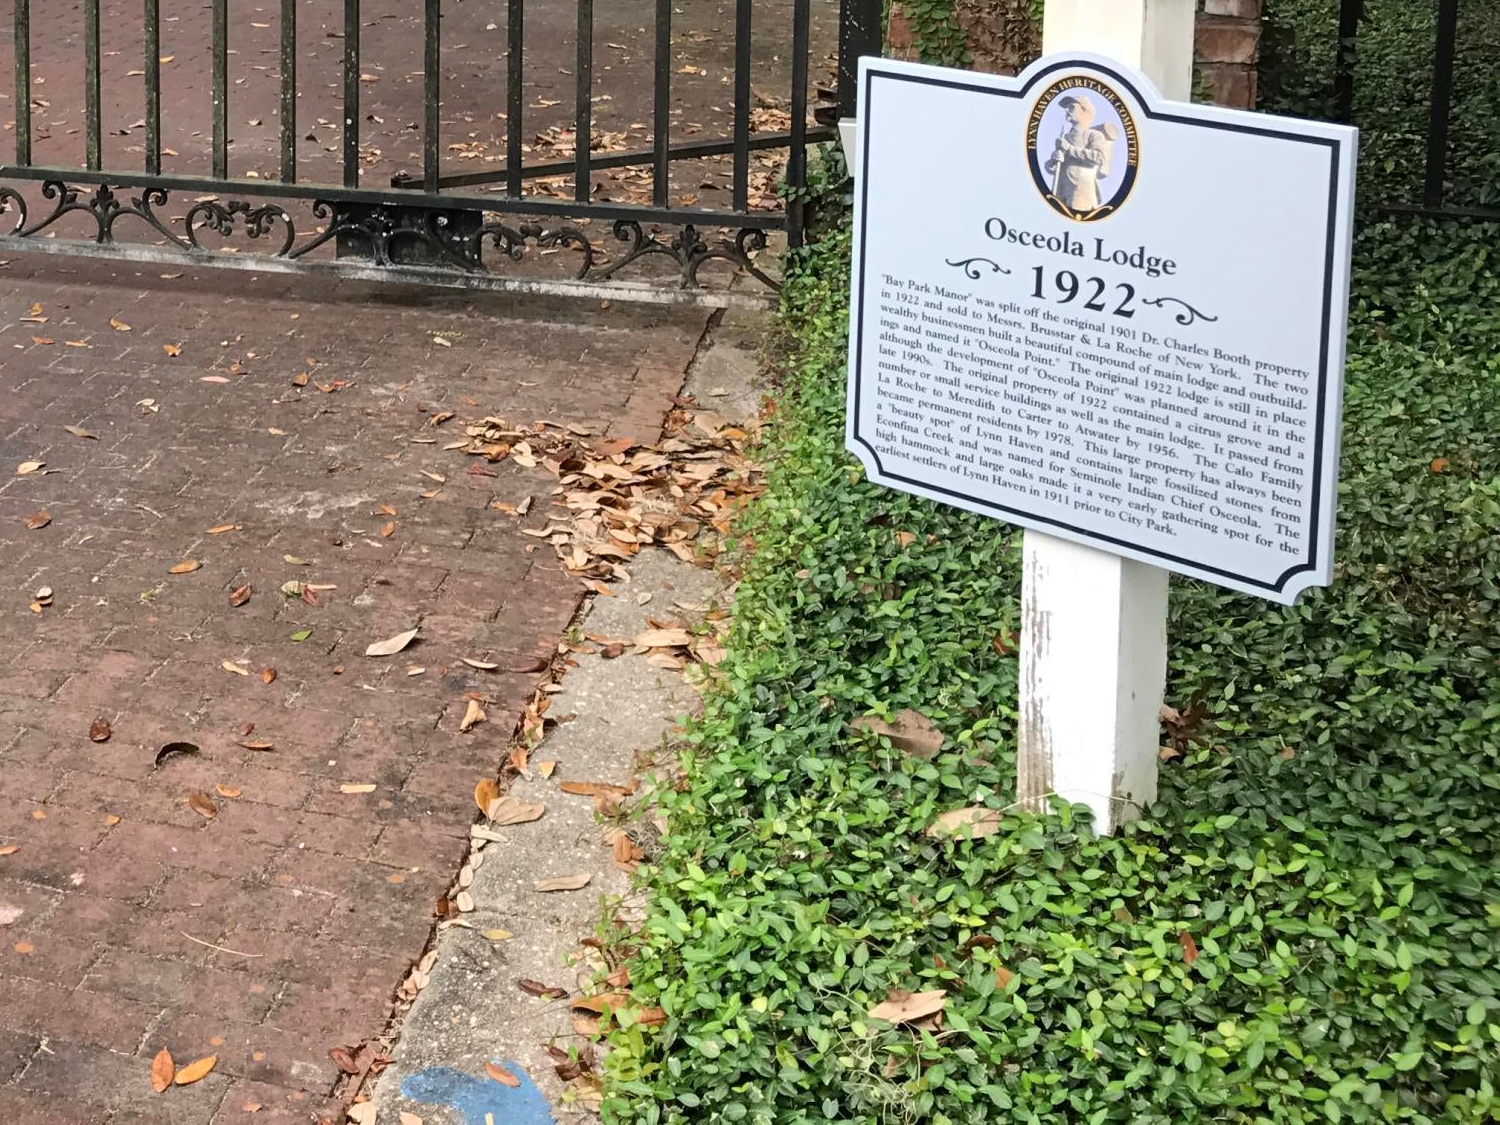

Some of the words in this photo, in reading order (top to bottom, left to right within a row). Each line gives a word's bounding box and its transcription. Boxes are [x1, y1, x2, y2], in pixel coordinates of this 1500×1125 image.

[984, 217, 1084, 257] Osceola
[1094, 237, 1177, 278] Lodge
[1030, 265, 1137, 319] 1922
[879, 315, 900, 331] ings
[902, 324, 922, 335] and
[925, 329, 960, 344] named
[1068, 360, 1092, 376] The
[1095, 370, 1139, 388] original
[1144, 379, 1172, 396] 1922
[1176, 386, 1210, 405] lodge
[1227, 401, 1251, 415] still
[1272, 411, 1307, 428] place
[880, 304, 919, 322] wealthy
[921, 311, 986, 336] businessmen
[988, 326, 1013, 342] built
[1024, 335, 1073, 357] beautiful
[1075, 350, 1136, 372] compound
[1153, 368, 1184, 383] main
[1186, 372, 1220, 392] lodge
[1222, 385, 1246, 397] and
[1248, 391, 1308, 411] outbuild-
[895, 291, 920, 306] 1922
[923, 300, 943, 311] and
[947, 304, 968, 317] sold
[986, 311, 1026, 330] Messrs.
[1030, 321, 1076, 342] Brusstar
[1079, 333, 1092, 346] &
[1096, 336, 1111, 350] La
[1115, 341, 1153, 360] Roche
[1174, 354, 1204, 371] New
[1208, 362, 1242, 380] York.
[1252, 372, 1279, 389] The
[1284, 382, 1309, 396] two
[907, 279, 931, 294] Park
[975, 297, 995, 309] was
[997, 301, 1021, 314] split
[1023, 306, 1041, 319] off
[1042, 310, 1060, 323] the
[1062, 316, 1106, 334] original
[1110, 324, 1136, 341] 1901
[1141, 331, 1160, 346] Dr.
[1163, 337, 1210, 357] Charles
[1213, 347, 1251, 367] Booth
[1254, 360, 1310, 381] property
[877, 371, 891, 384] La
[895, 376, 928, 394] Roche
[947, 389, 996, 412] Meredith
[1017, 408, 1053, 426] Carter
[1075, 423, 1121, 444] Atwater
[1125, 435, 1141, 451] by
[1148, 442, 1179, 460] 1956.
[1192, 453, 1219, 470] The
[1224, 462, 1254, 479] Calo
[1260, 470, 1304, 493] Family
[878, 343, 897, 357] late
[902, 350, 933, 367] 1990s.
[943, 359, 964, 374] The
[967, 368, 1008, 386] original
[1012, 380, 1059, 400] property
[1080, 394, 1107, 410] 1922
[1112, 405, 1170, 426] contained
[1187, 422, 1222, 439] citrus
[1227, 434, 1262, 449] grove
[1267, 444, 1292, 457] and
[878, 360, 917, 377] number
[933, 375, 961, 388] small
[963, 382, 1001, 398] service
[1003, 389, 1052, 412] buildings
[1070, 409, 1094, 422] well
[1113, 418, 1132, 432] the
[1135, 426, 1165, 440] main
[1168, 431, 1205, 451] lodge.
[1213, 442, 1225, 456] It
[1227, 450, 1269, 467] passed
[1273, 458, 1304, 476] from
[879, 330, 923, 350] although
[926, 341, 943, 355] the
[946, 346, 1014, 372] development
[1017, 364, 1031, 376] of
[1123, 392, 1146, 404] was
[1150, 397, 1199, 418] planned
[1202, 412, 1247, 430] around
[1285, 429, 1306, 444] the
[874, 444, 910, 460] earliest
[912, 454, 948, 471] settlers
[962, 465, 989, 483] Lynn
[992, 474, 1027, 494] Haven
[1044, 489, 1070, 506] 1911
[1073, 500, 1102, 515] prior
[1118, 510, 1144, 528] City
[1146, 517, 1178, 537] Park.
[875, 427, 897, 443] high
[901, 434, 951, 458] hammock
[954, 452, 975, 464] and
[979, 455, 1005, 473] large
[1008, 467, 1035, 480] oaks
[1038, 475, 1069, 490] made
[1098, 492, 1123, 507] very
[1127, 500, 1158, 517] early
[1161, 510, 1219, 535] gathering
[1223, 527, 1250, 542] spot
[1255, 533, 1274, 548] for
[1279, 540, 1300, 556] the
[876, 413, 919, 435] Econfina
[923, 426, 954, 444] Creek
[958, 439, 979, 451] and
[983, 445, 1003, 457] was
[1007, 452, 1044, 469] named
[1048, 460, 1066, 474] for
[1069, 466, 1122, 490] Seminole
[1127, 482, 1165, 502] Indian
[1170, 494, 1205, 513] Chief
[1208, 505, 1262, 529] Osceola.
[1274, 522, 1301, 540] The
[877, 385, 915, 405] became
[917, 399, 973, 420] permanent
[976, 414, 1023, 433] residents
[1026, 424, 1040, 439] by
[1045, 430, 1075, 447] 1978.
[1083, 439, 1109, 456] This
[1112, 447, 1141, 465] large
[1144, 459, 1196, 481] property
[1200, 470, 1221, 486] has
[1224, 479, 1267, 499] always
[1271, 489, 1302, 508] been
[976, 426, 1003, 443] Lynn
[1008, 434, 1044, 454] Haven
[1049, 449, 1070, 461] and
[1075, 456, 1124, 475] contains
[1129, 467, 1158, 485] large
[1164, 477, 1219, 502] fossilized
[1225, 496, 1264, 513] stones
[1270, 505, 1301, 524] from
